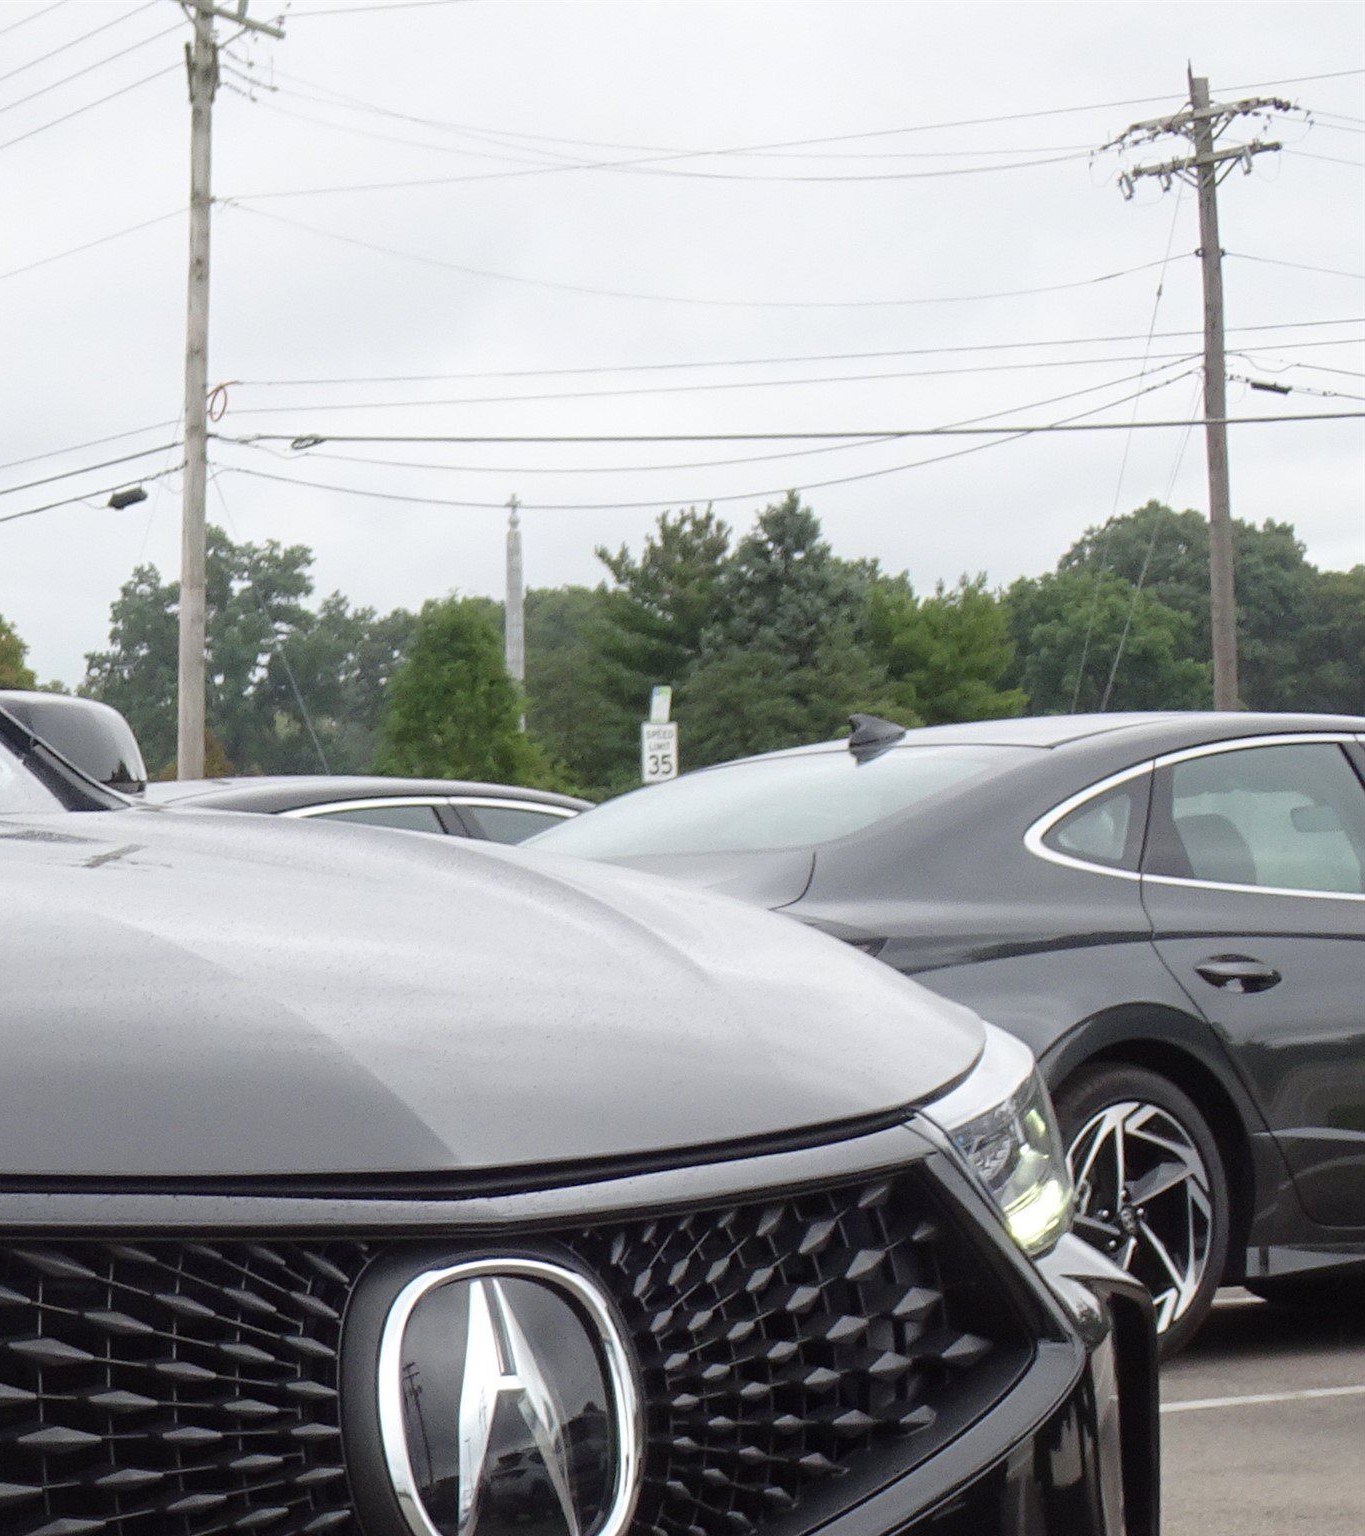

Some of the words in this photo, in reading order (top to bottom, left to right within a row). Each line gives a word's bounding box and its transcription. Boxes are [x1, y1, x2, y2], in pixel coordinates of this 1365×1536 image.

[646, 729, 674, 740] SPEED
[648, 741, 671, 752] LIMIT
[648, 754, 673, 776] 35
